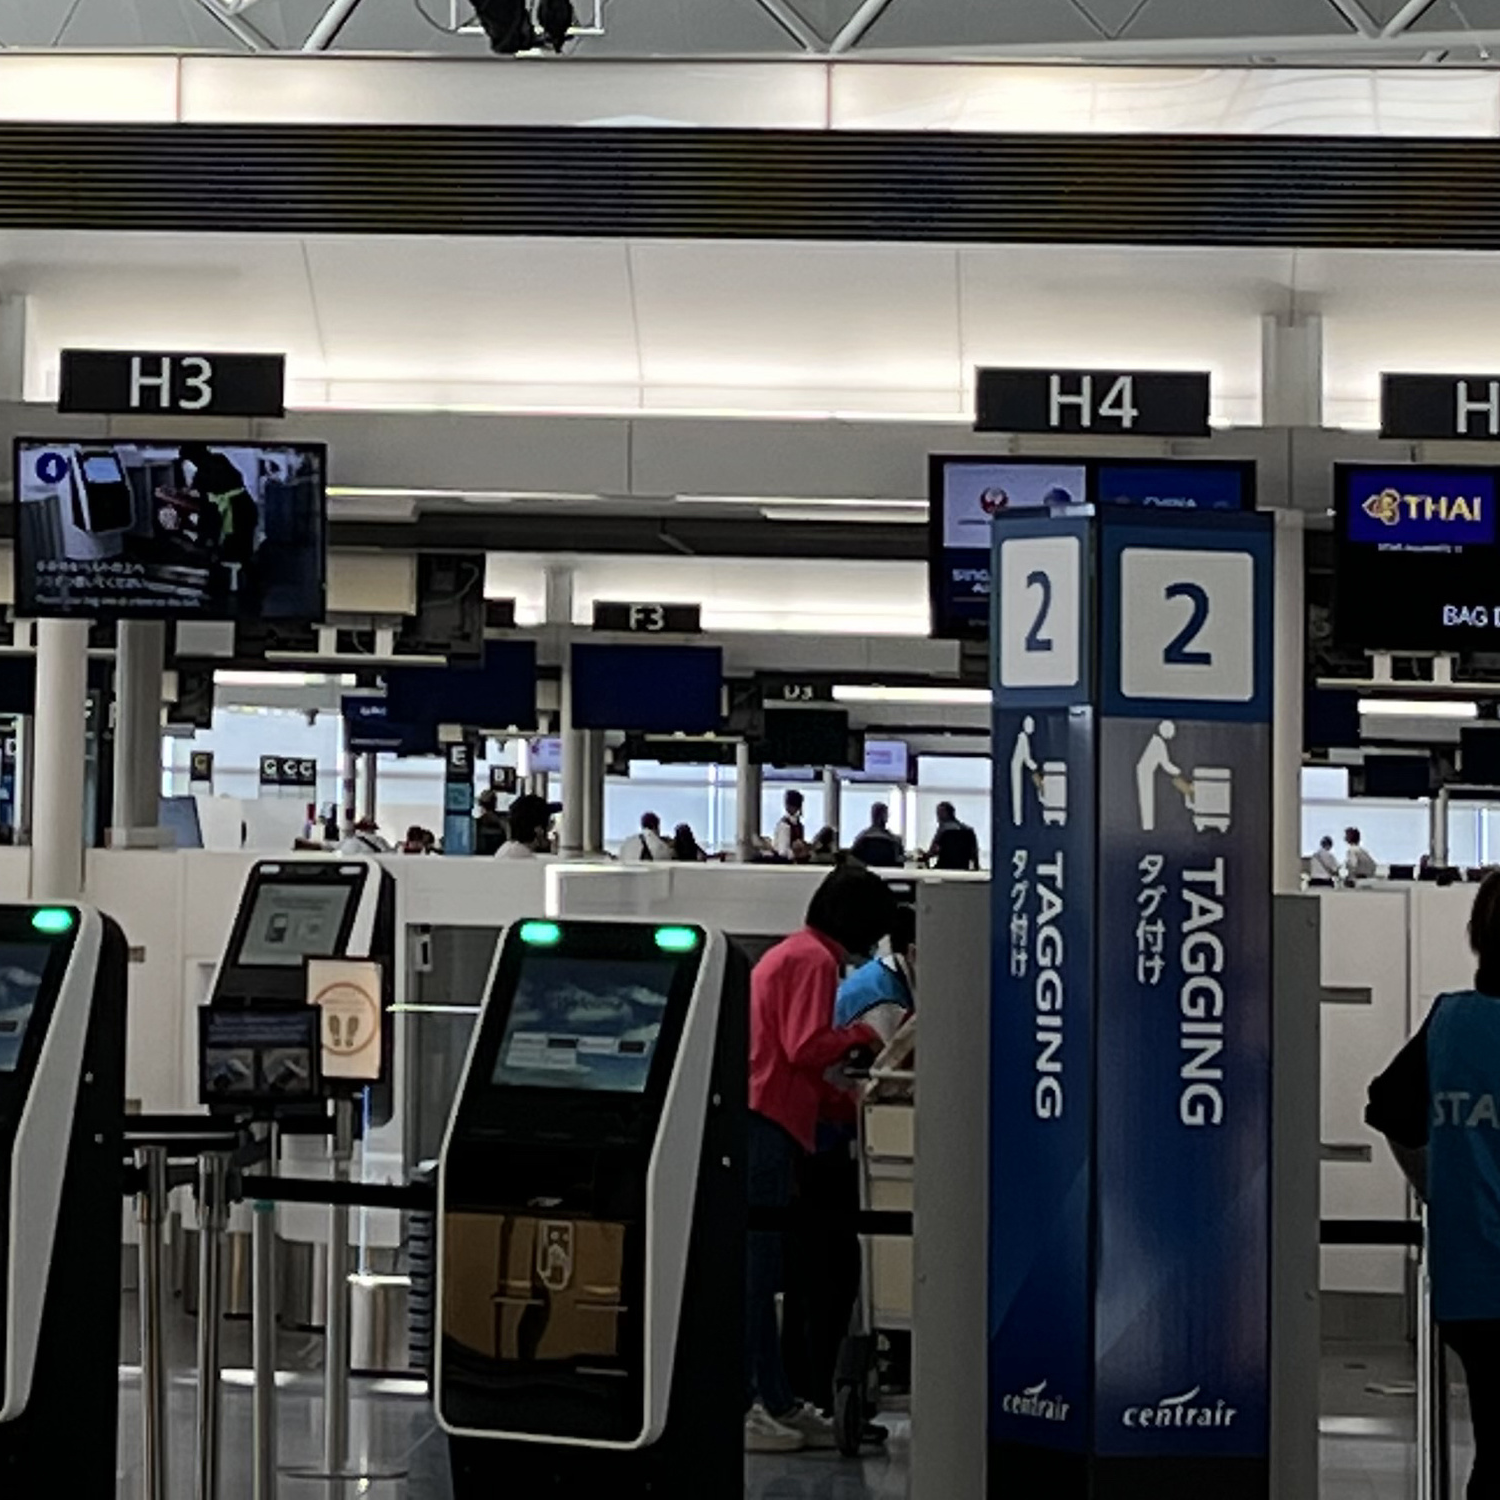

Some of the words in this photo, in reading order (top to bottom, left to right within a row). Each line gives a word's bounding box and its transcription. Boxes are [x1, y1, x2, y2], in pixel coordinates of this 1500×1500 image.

[129, 356, 213, 409] H3
[1049, 374, 1139, 428] H4
[1404, 495, 1482, 521] THAI
[629, 604, 664, 630] F3
[1025, 570, 1053, 652] 2
[1163, 582, 1212, 665] 2
[1443, 604, 1489, 627] BAG
[1011, 850, 1028, 978] タグ付け
[1137, 855, 1167, 984] タグ付け
[1036, 851, 1063, 1119] TAGGING
[1180, 857, 1224, 1127] TAGGING
[1002, 1394, 1070, 1421] centrair
[1122, 1399, 1238, 1427] centrair
